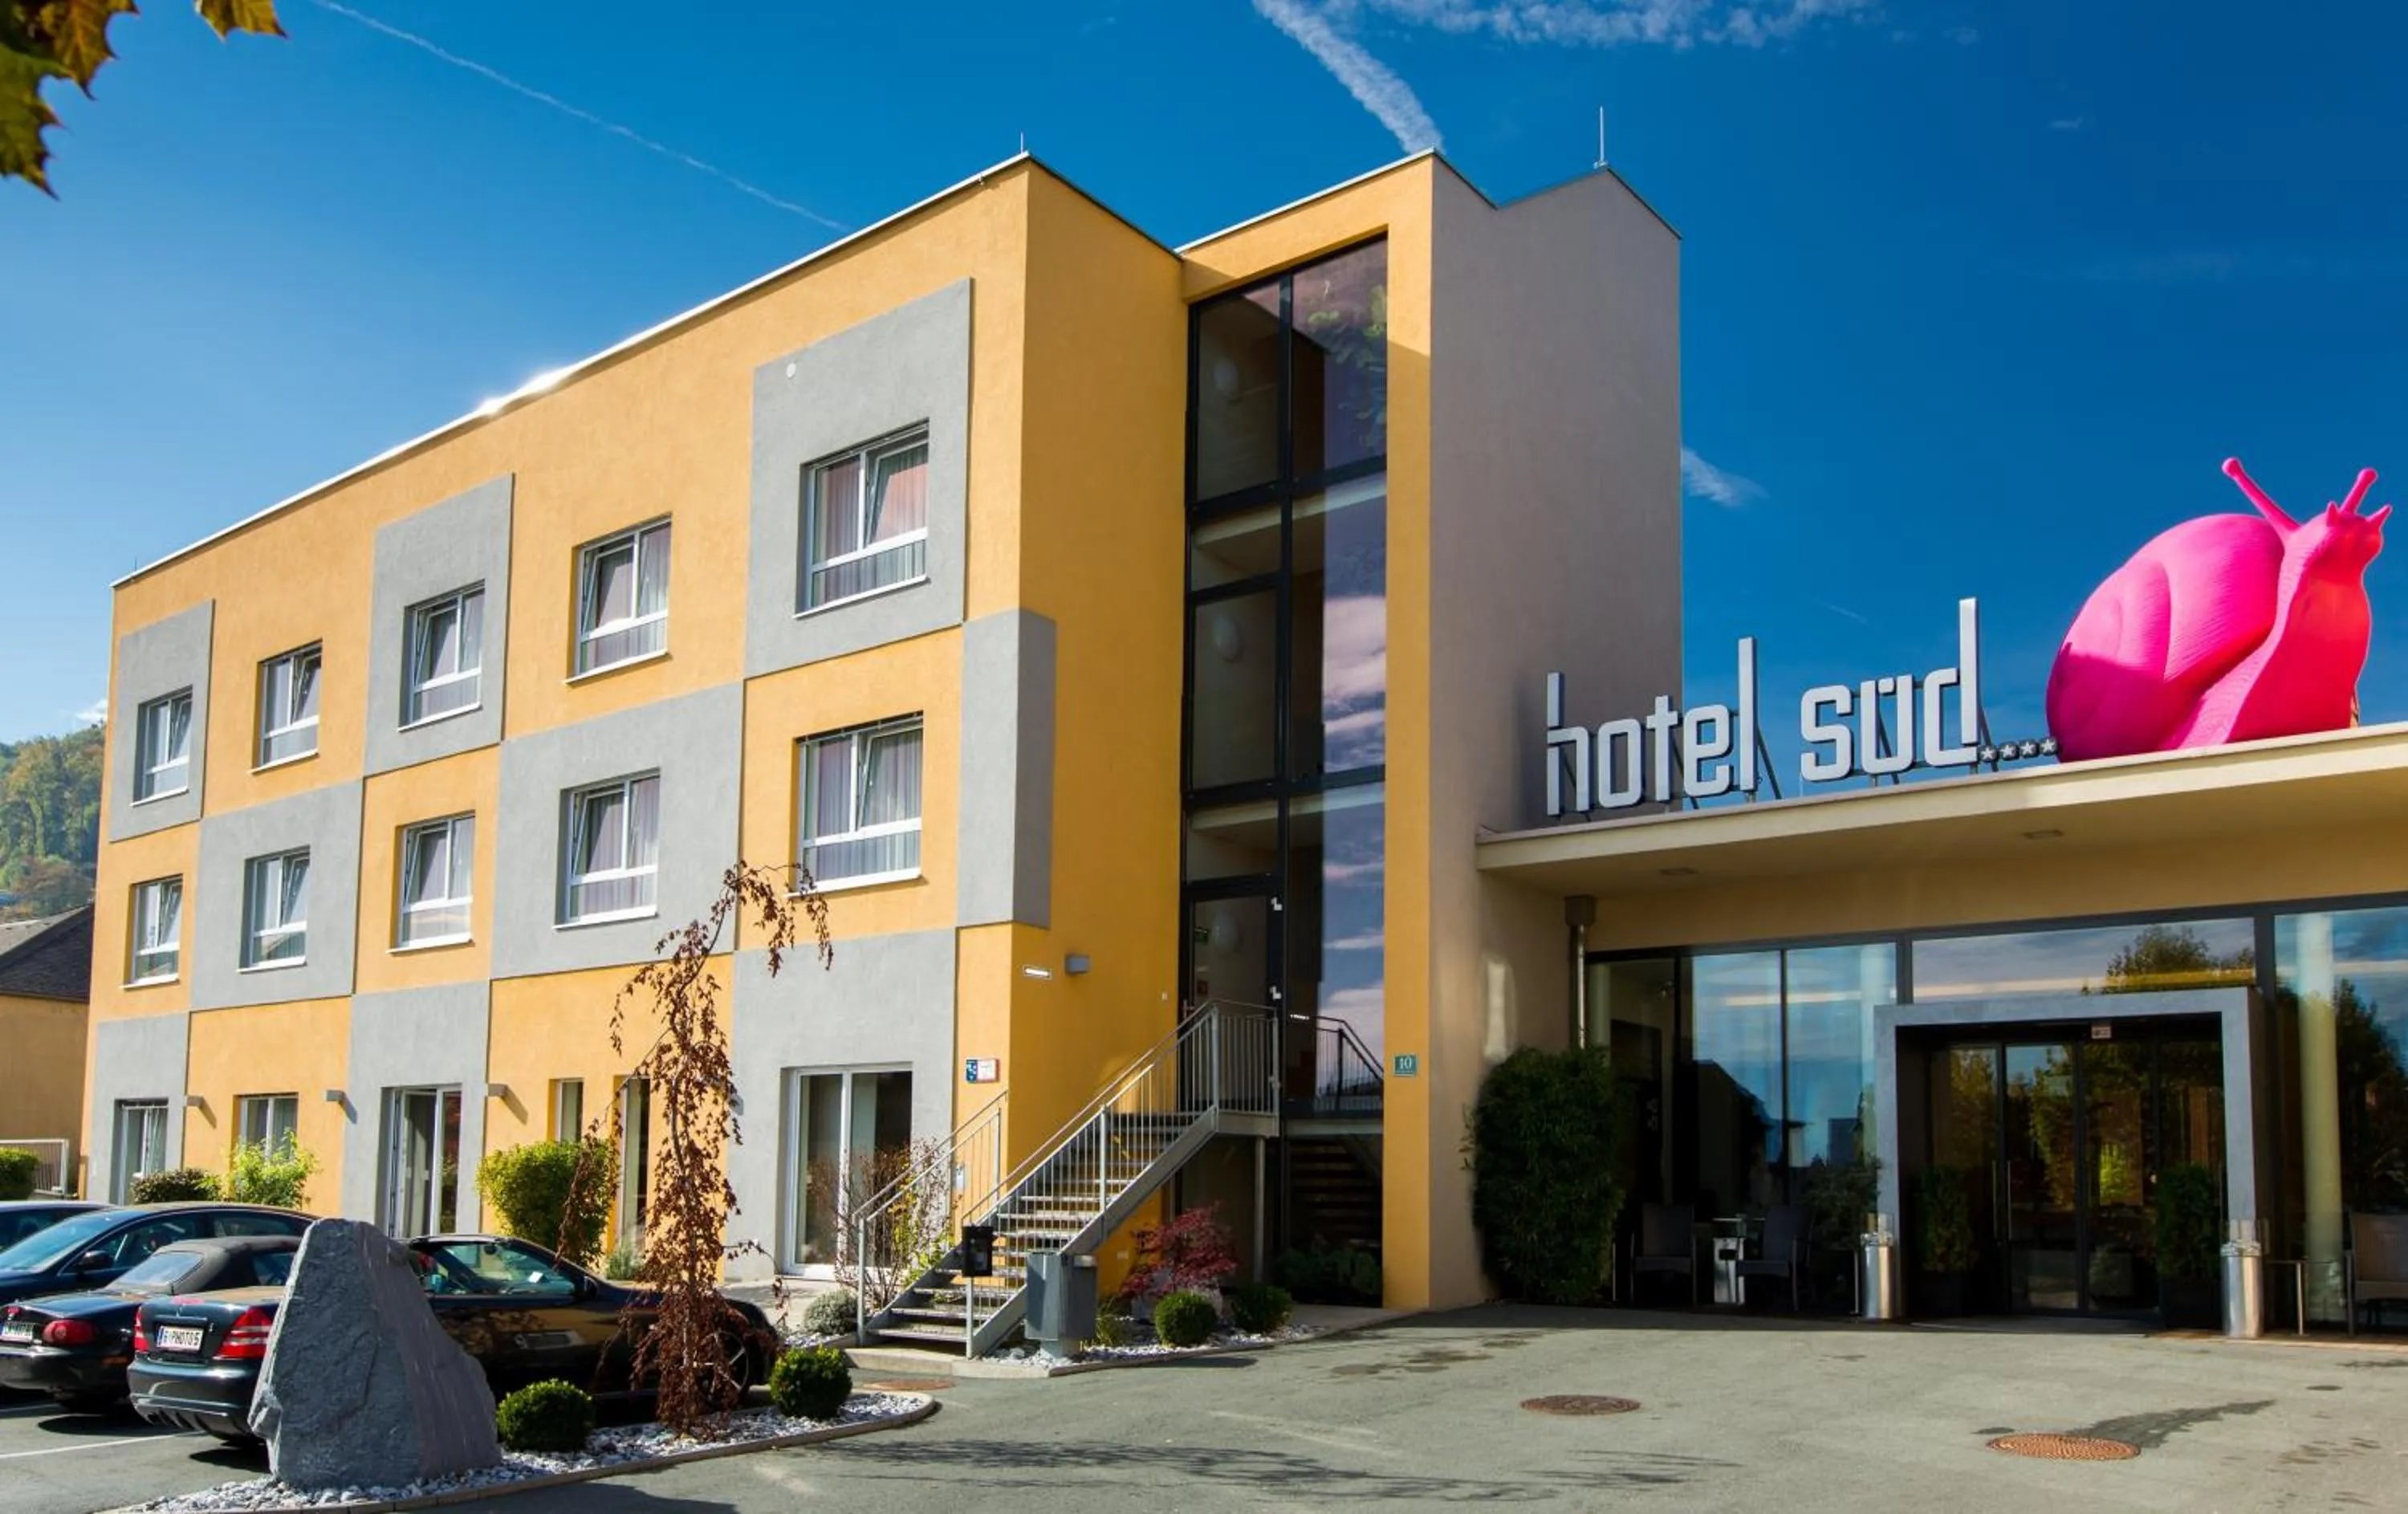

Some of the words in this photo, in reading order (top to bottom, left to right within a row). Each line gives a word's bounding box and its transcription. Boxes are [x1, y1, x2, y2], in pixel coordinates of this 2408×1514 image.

[1546, 637, 1758, 817] hotel
[1800, 597, 1979, 782] süd
[1399, 1056, 1413, 1069] 10
